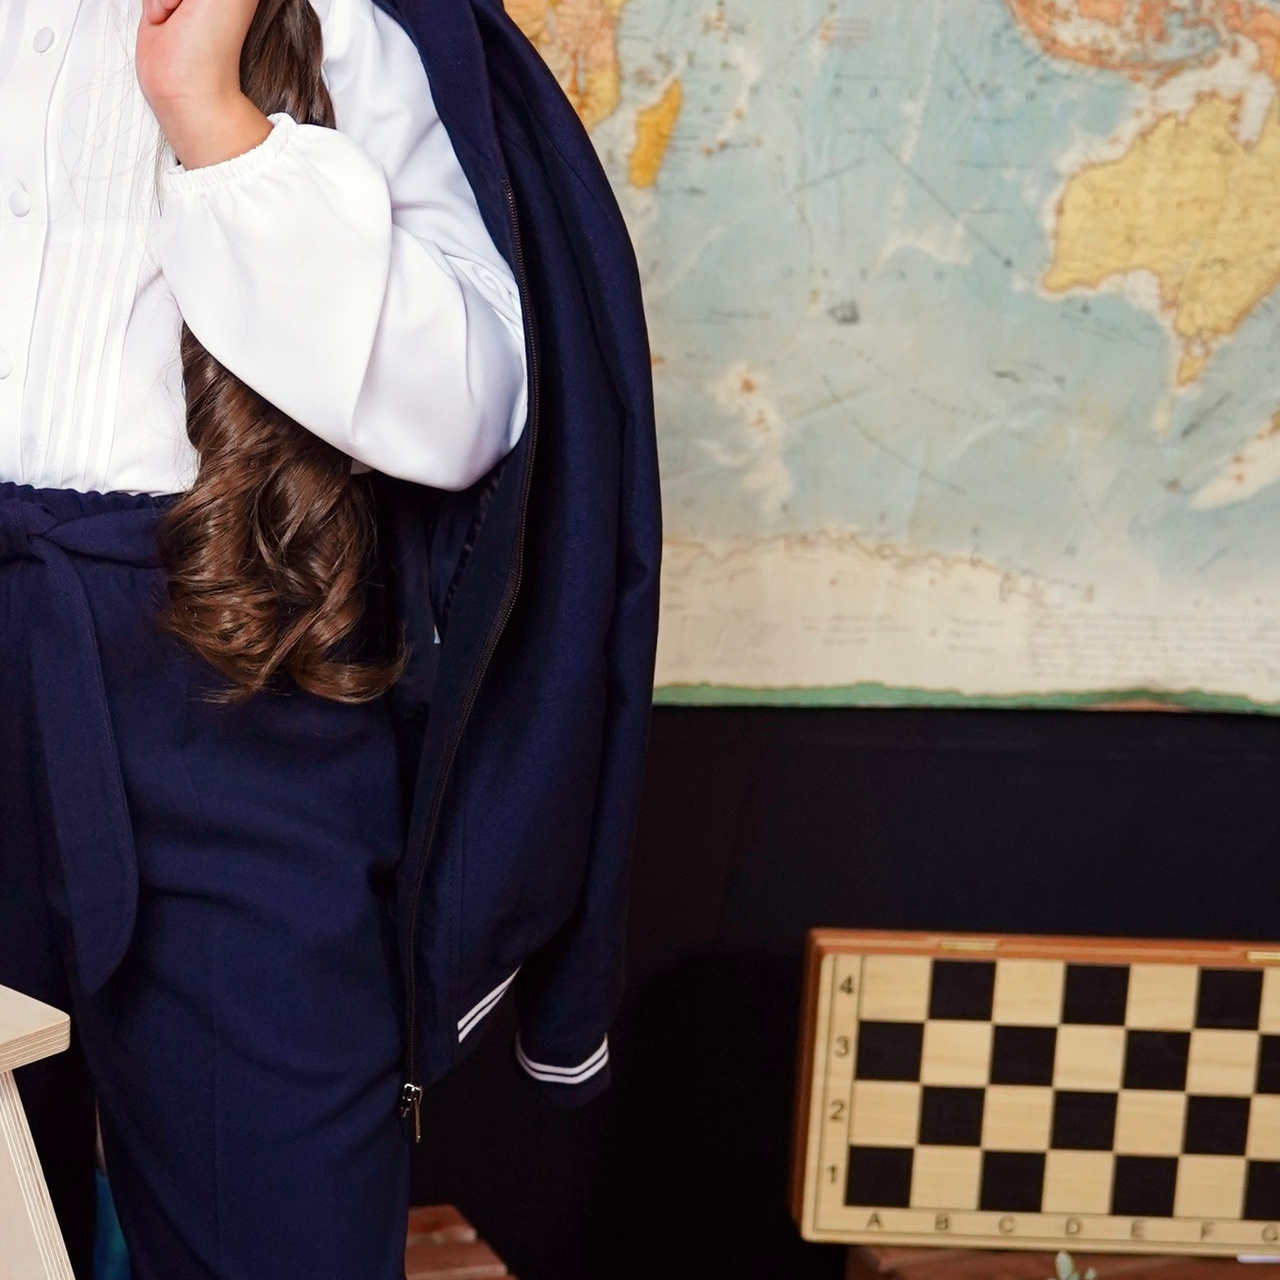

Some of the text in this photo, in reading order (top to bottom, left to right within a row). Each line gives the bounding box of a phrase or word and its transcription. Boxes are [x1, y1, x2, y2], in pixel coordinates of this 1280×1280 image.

[839, 974, 854, 995] 4
[835, 1035, 850, 1058] 3
[830, 1100, 845, 1122] 2
[827, 1164, 837, 1184] 1
[866, 1211, 884, 1231] A
[1065, 1217, 1082, 1237] D
